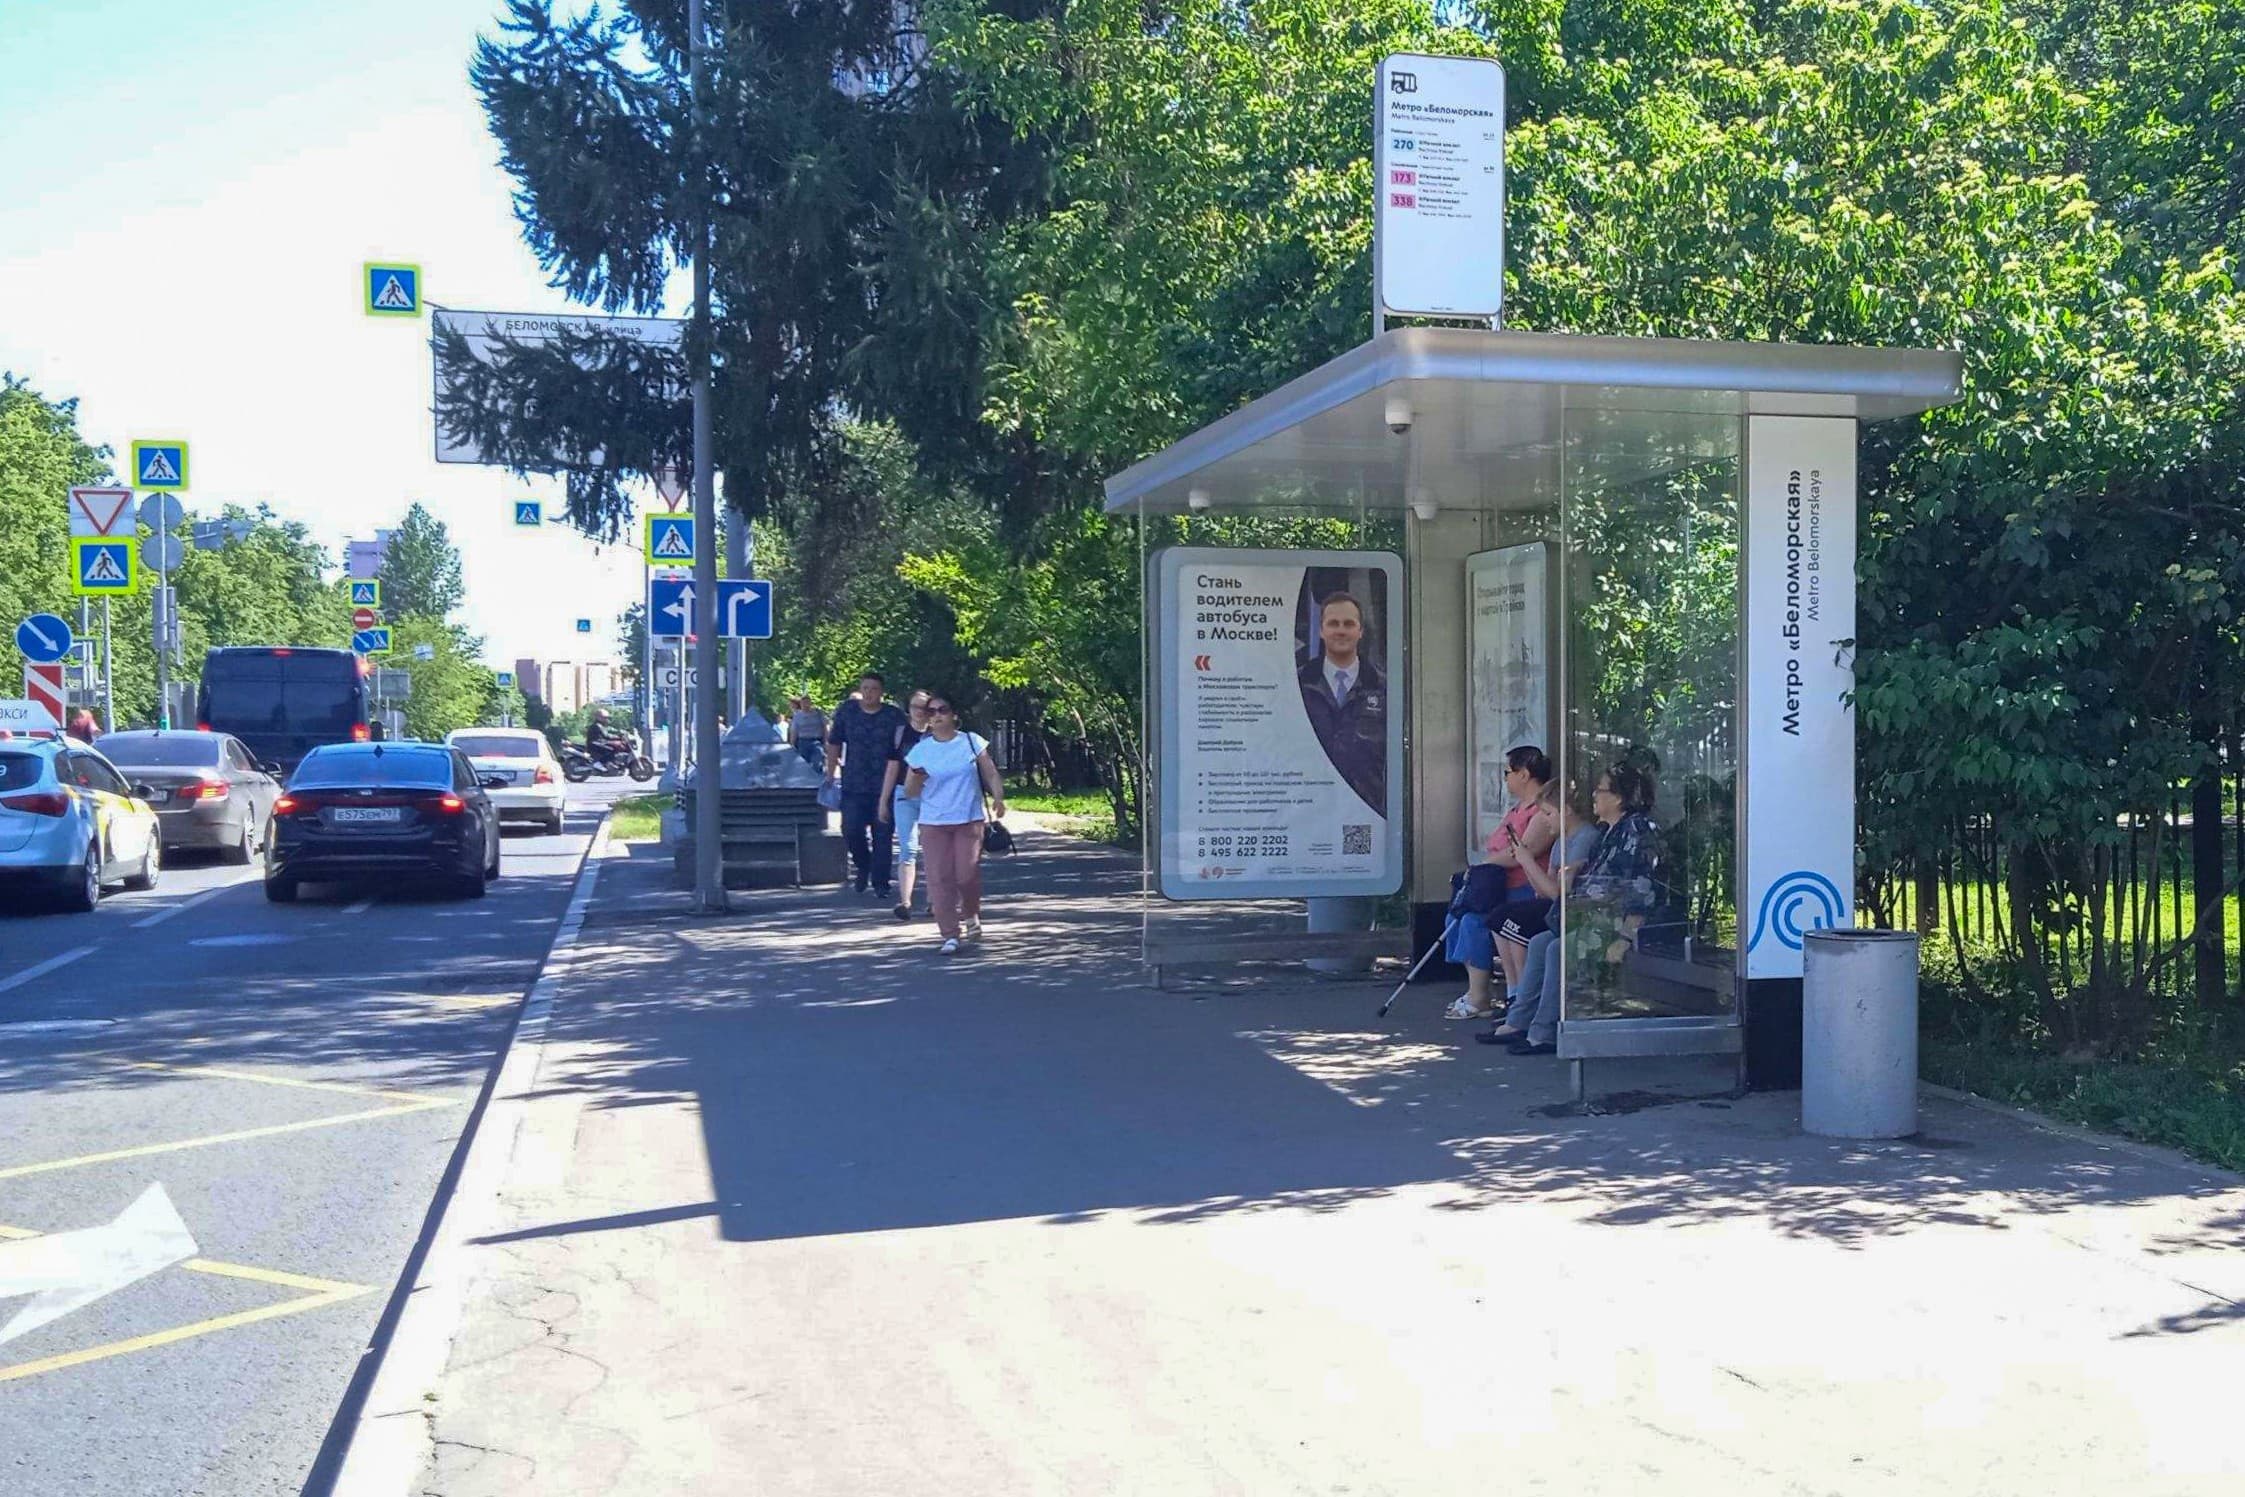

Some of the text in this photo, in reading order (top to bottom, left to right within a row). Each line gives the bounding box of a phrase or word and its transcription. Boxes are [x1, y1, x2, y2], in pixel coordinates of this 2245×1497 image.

[1391, 101, 1494, 118] Метро «Беломорская»
[1393, 139, 1414, 150] 270
[1394, 173, 1412, 184] 173
[1393, 196, 1413, 207] 338
[1807, 470, 1823, 621] Metro Belomorskaya
[1197, 574, 1242, 589] Стань
[1197, 595, 1284, 607] водителем
[1782, 470, 1804, 736] Метро «Беломорская»
[1197, 609, 1267, 626] автобуса
[1197, 627, 1278, 641] в Москве!
[1198, 835, 1288, 846] 8 800 220 2202
[1198, 847, 1288, 858] 8 495 622 2222
